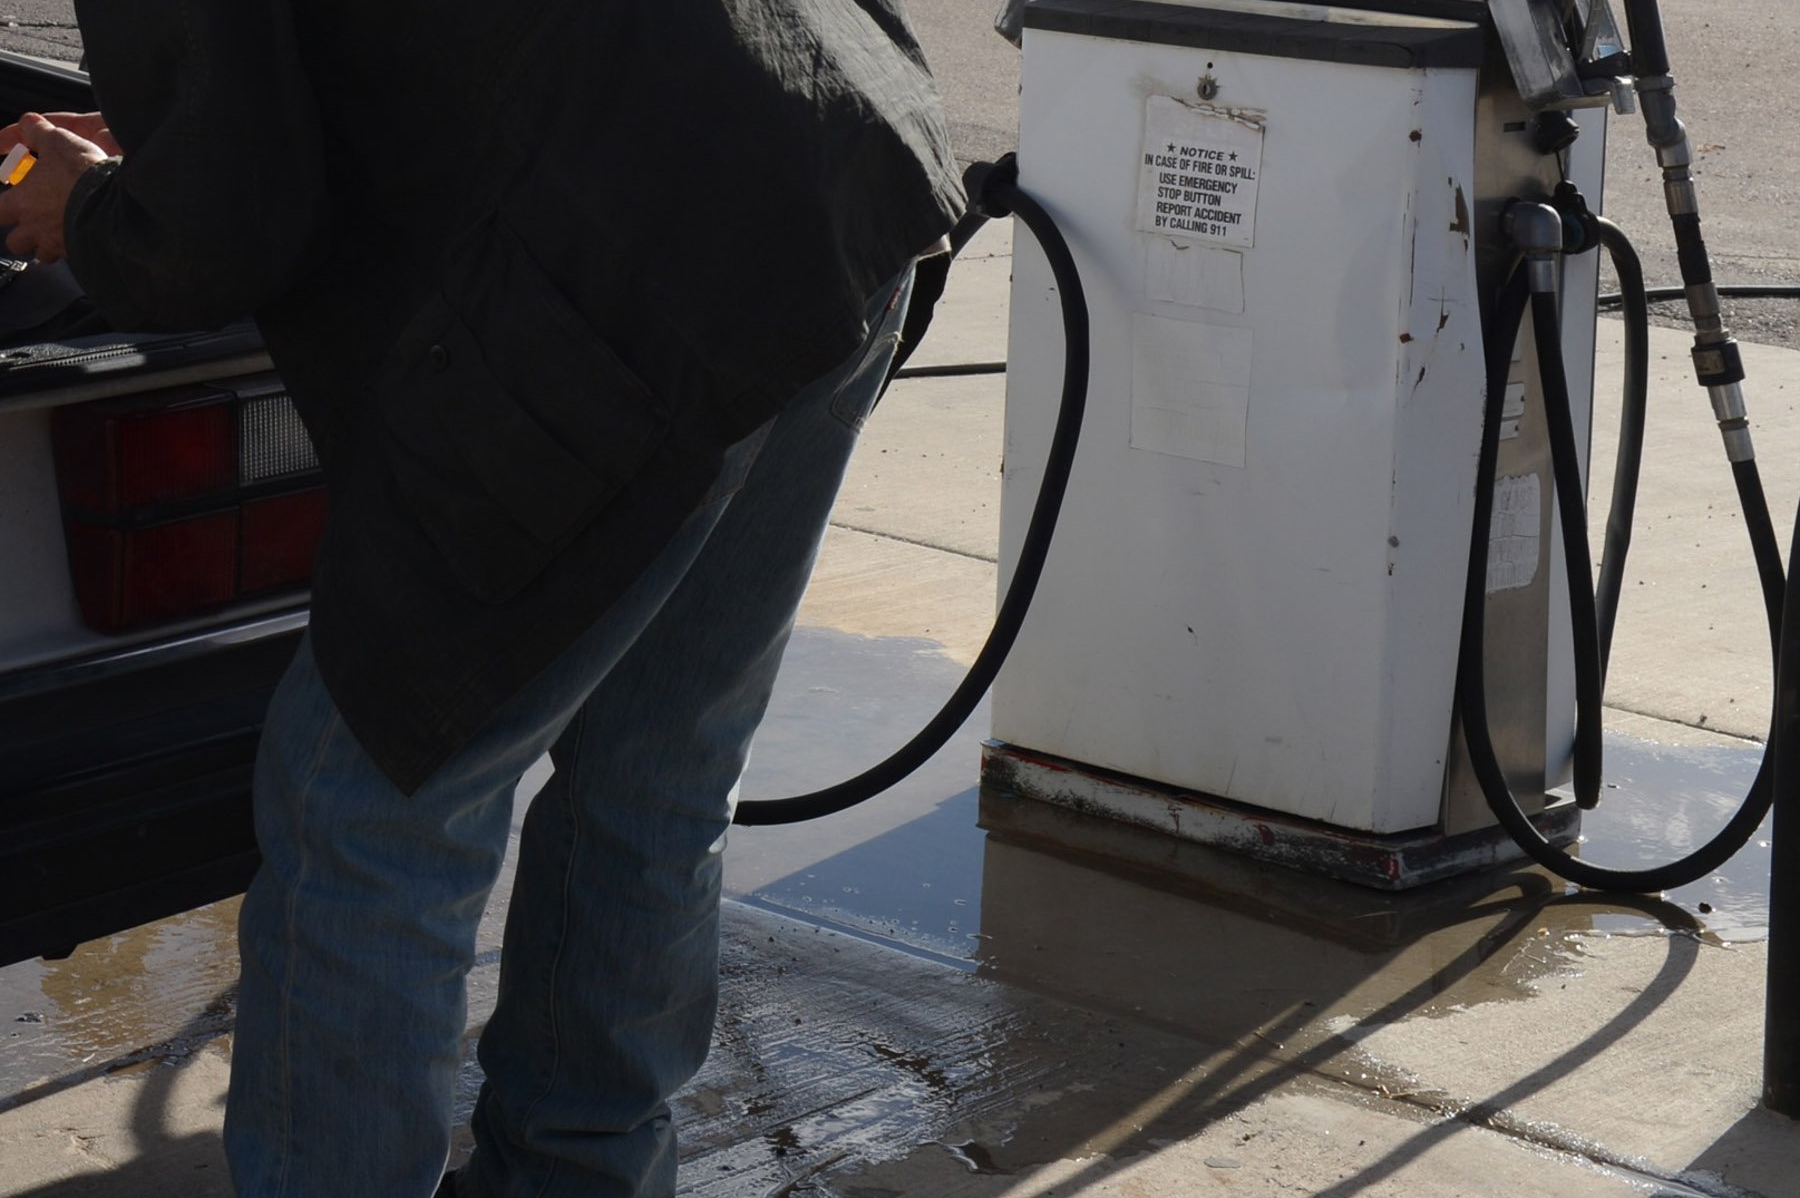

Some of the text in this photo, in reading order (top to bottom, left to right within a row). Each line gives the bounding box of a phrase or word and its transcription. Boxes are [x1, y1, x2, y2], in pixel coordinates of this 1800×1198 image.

[1180, 146, 1224, 161] NOTICE
[1145, 154, 1255, 180] IN CASE OF FIRE OR SPILL:
[1159, 172, 1238, 194] USE EMERGENCY
[1158, 187, 1222, 206] STOP BUTTON
[1157, 202, 1241, 224] REPORT ACCIDENT
[1155, 215, 1226, 237] BY CALLING 911
